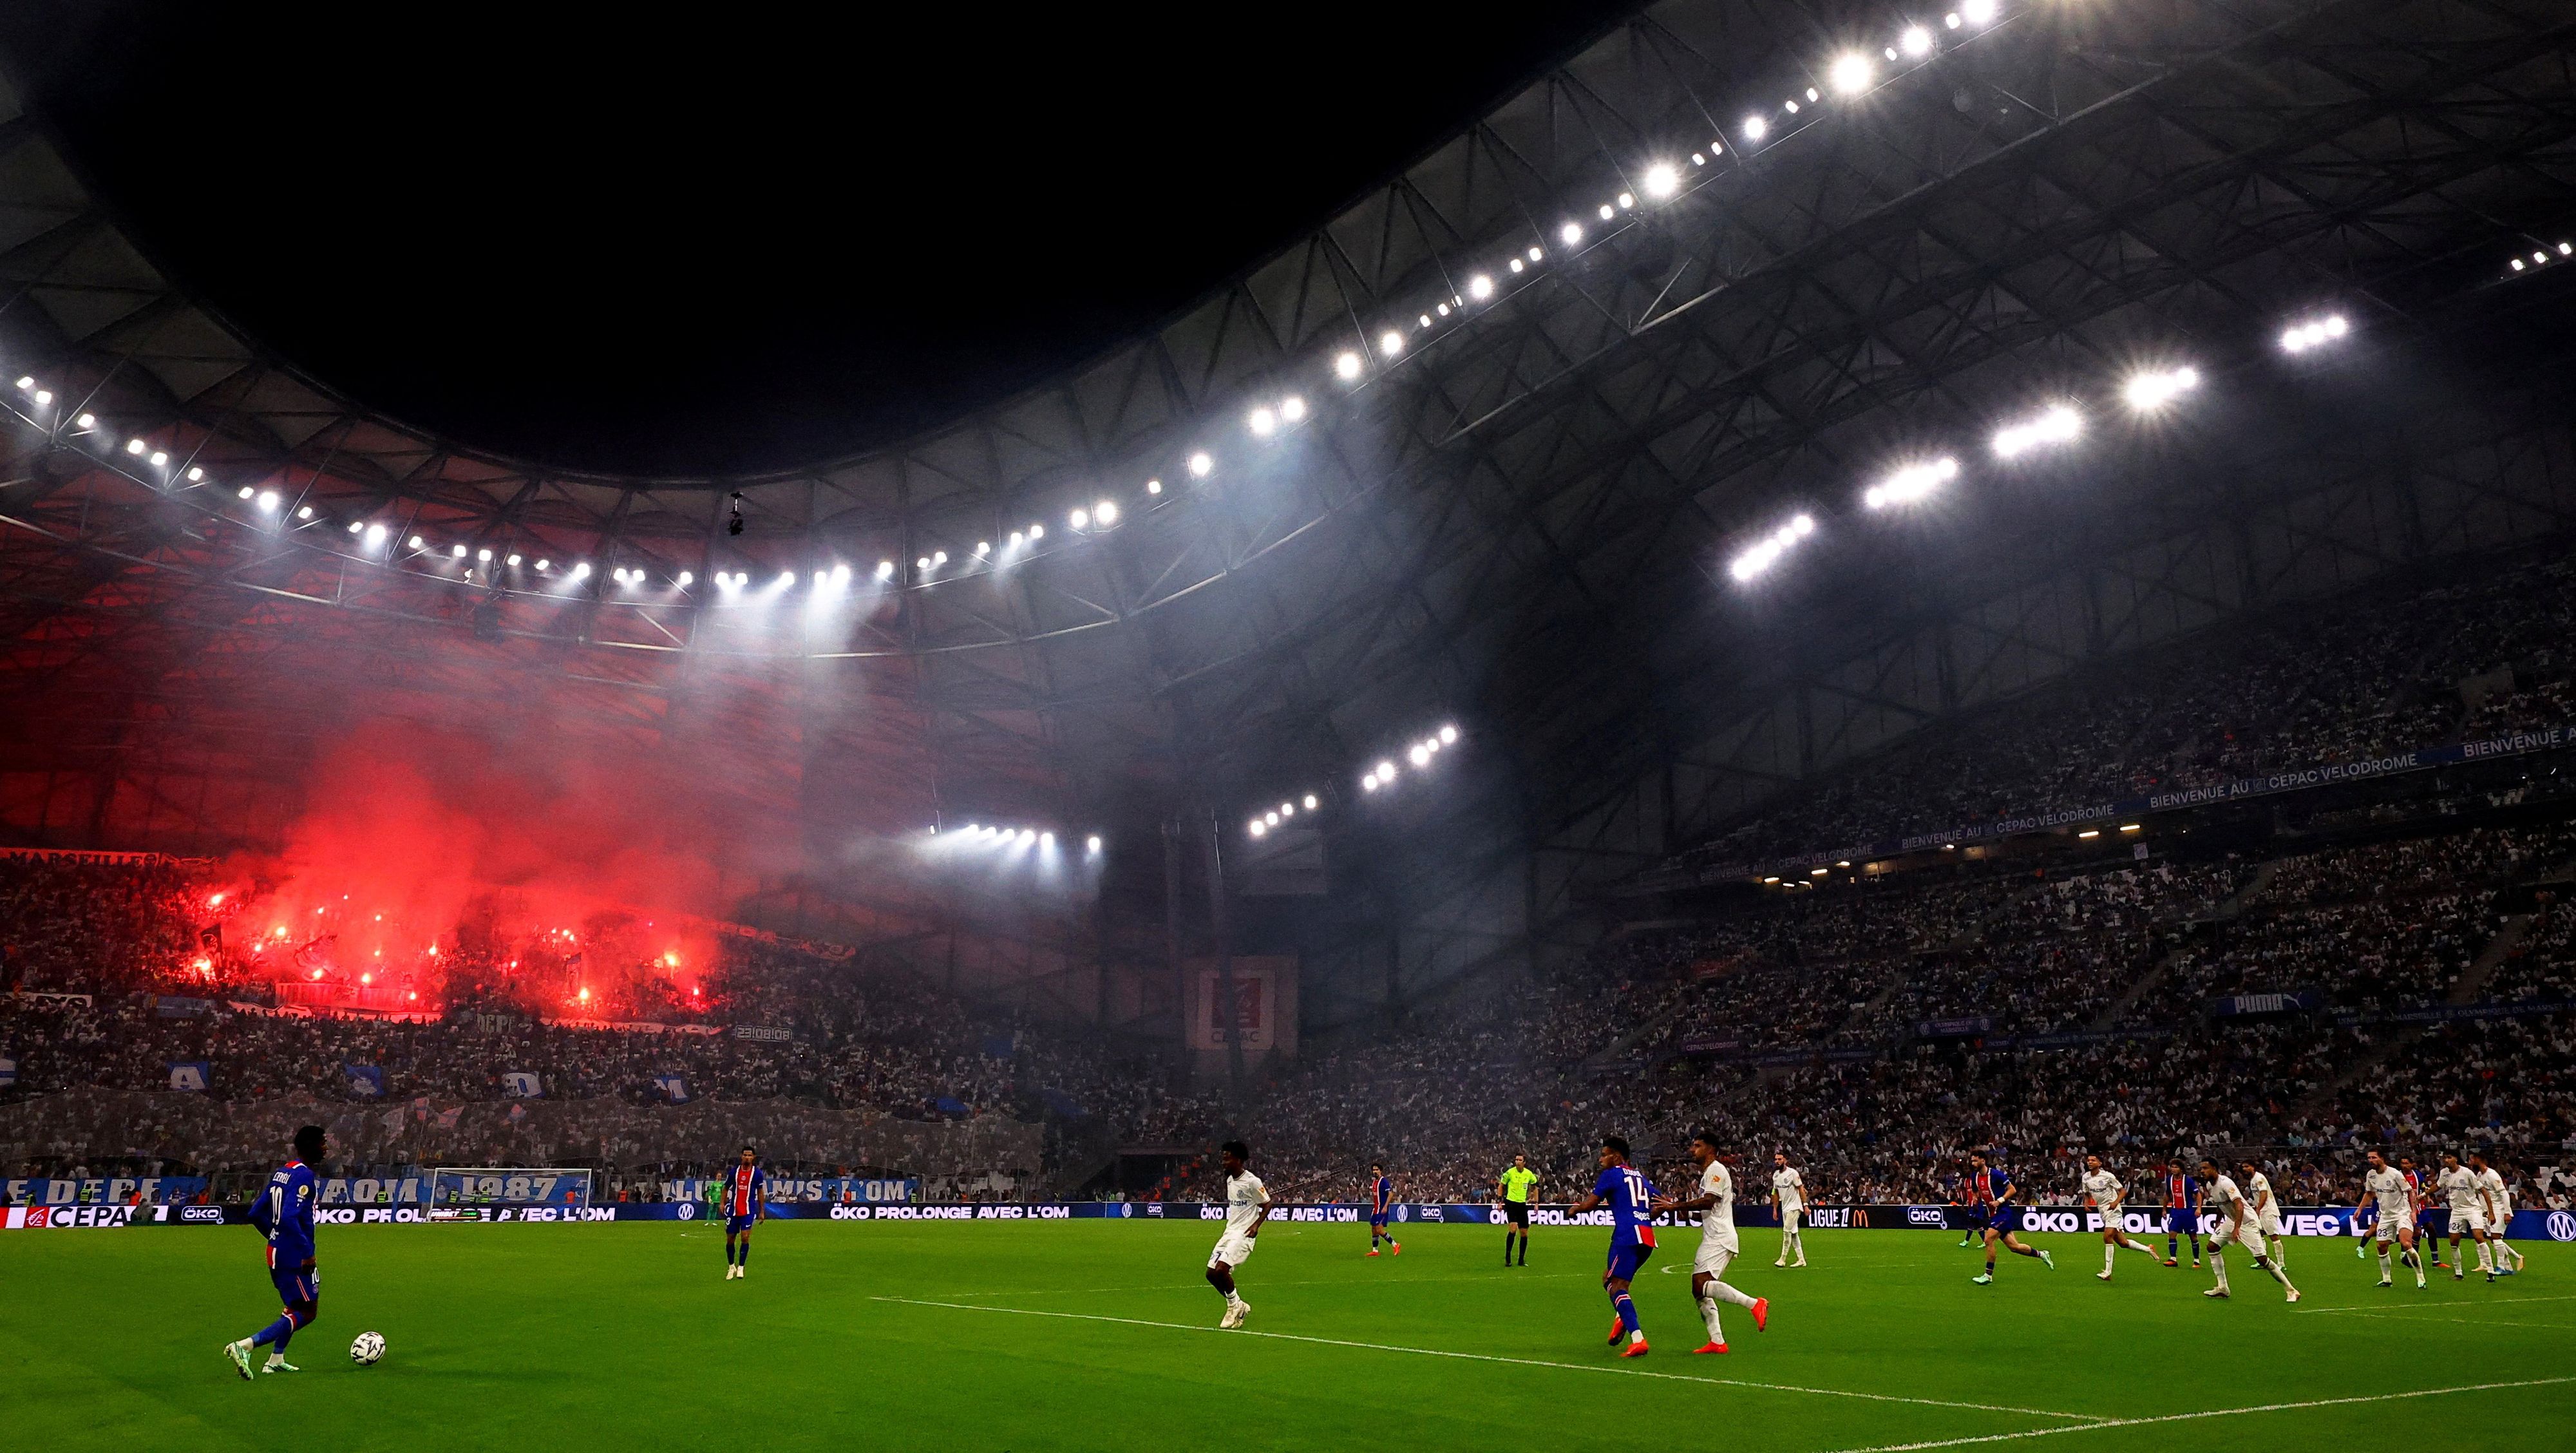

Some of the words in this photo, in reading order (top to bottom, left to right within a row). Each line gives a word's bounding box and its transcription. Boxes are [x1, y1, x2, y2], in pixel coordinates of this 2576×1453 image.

[2463, 729, 2561, 757] BIENVENUE
[2150, 787, 2226, 809] BIENVENUE
[2230, 781, 2249, 795] AU
[2269, 770, 2318, 789] CEPAC
[2320, 753, 2418, 781] VELODROME
[1902, 830, 1962, 850] BIENVENUE
[1965, 826, 1982, 839] AU
[1996, 817, 2035, 833] CEPAC
[2038, 804, 2114, 826] VELODROME
[1778, 857, 1809, 869] CEPAC
[2235, 994, 2284, 1014] PUMA
[1211, 1031, 1259, 1042] CAC
[460, 1177, 556, 1201] 1987
[1624, 1176, 1649, 1209] 14
[184, 1208, 220, 1219] ÖKO
[270, 1186, 282, 1225] 10
[830, 1203, 870, 1219] ÖKO
[875, 1206, 972, 1219] PROLONGE
[977, 1206, 1023, 1219] AVEC
[1027, 1206, 1069, 1219] L'OM
[1200, 1203, 1224, 1220] ÖKO
[1291, 1208, 1324, 1222] AVEC
[1327, 1208, 1358, 1222] L'OM
[1910, 1208, 1941, 1221] ÖKO
[50, 1206, 129, 1227] CEPA
[1808, 1210, 1839, 1227] LIGUE
[2022, 1206, 2079, 1233] ÖKO
[2378, 1229, 2387, 1237] 23
